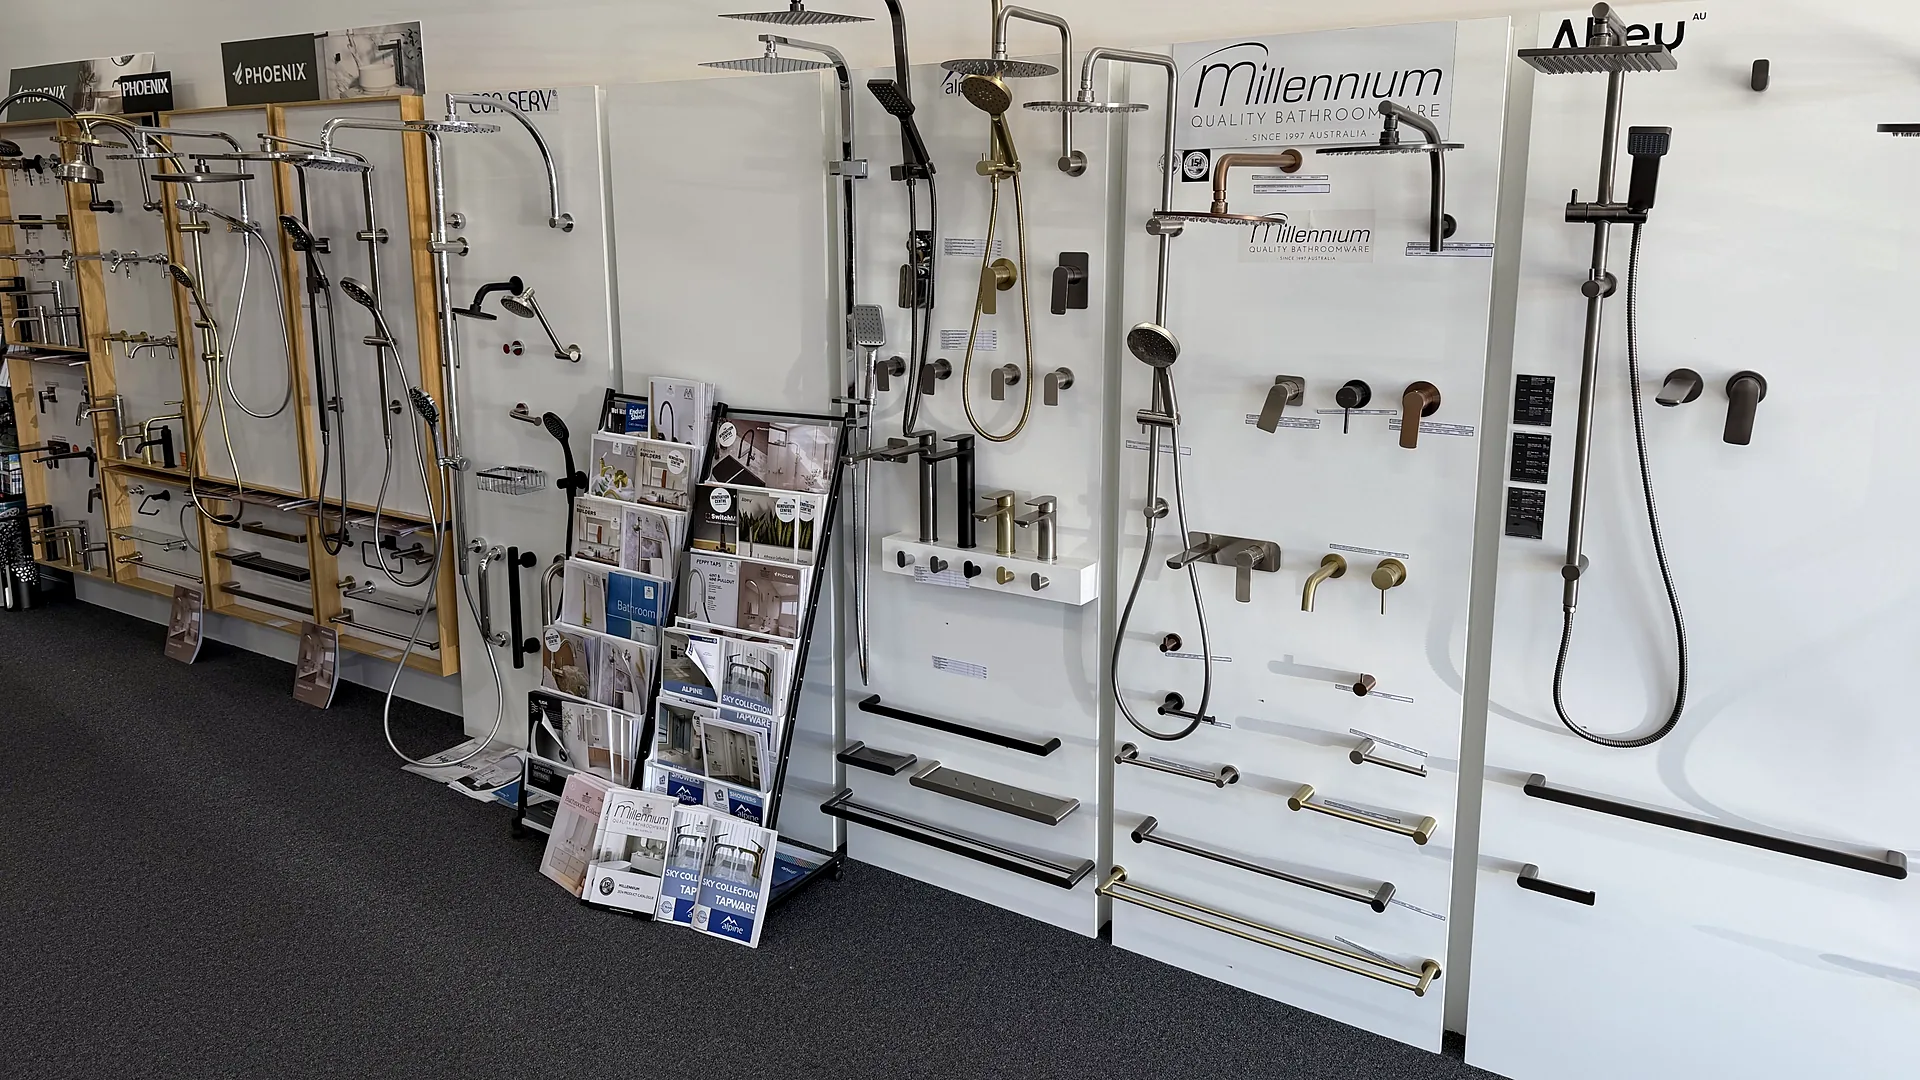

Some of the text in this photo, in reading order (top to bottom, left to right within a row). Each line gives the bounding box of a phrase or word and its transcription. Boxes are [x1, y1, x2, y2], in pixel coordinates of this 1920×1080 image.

[1692, 12, 1707, 21] AU
[244, 62, 307, 84] PHOENIX
[122, 77, 170, 97] PHOENIX
[1193, 60, 1443, 109] Millennium
[1191, 103, 1441, 128] QUALITY BATHROOMRE
[1252, 129, 1367, 142] SINCE 1997 AUSTRALIA
[1250, 223, 1371, 243] Millennium
[1249, 245, 1370, 253] QUALITY BATHROOMWARE
[640, 452, 661, 460] BUILDERS
[576, 507, 597, 517] BUILDERS
[617, 599, 656, 619] Bathroom
[681, 685, 703, 696] ALPINE
[722, 694, 773, 715] SKY COLLECTION
[736, 711, 771, 728] TAPWARE
[613, 804, 669, 826] Millennium
[666, 868, 679, 878] SKY
[702, 877, 759, 899] SKY COLLECTION
[715, 894, 756, 915] TAPWARE
[721, 921, 744, 935] alpine
